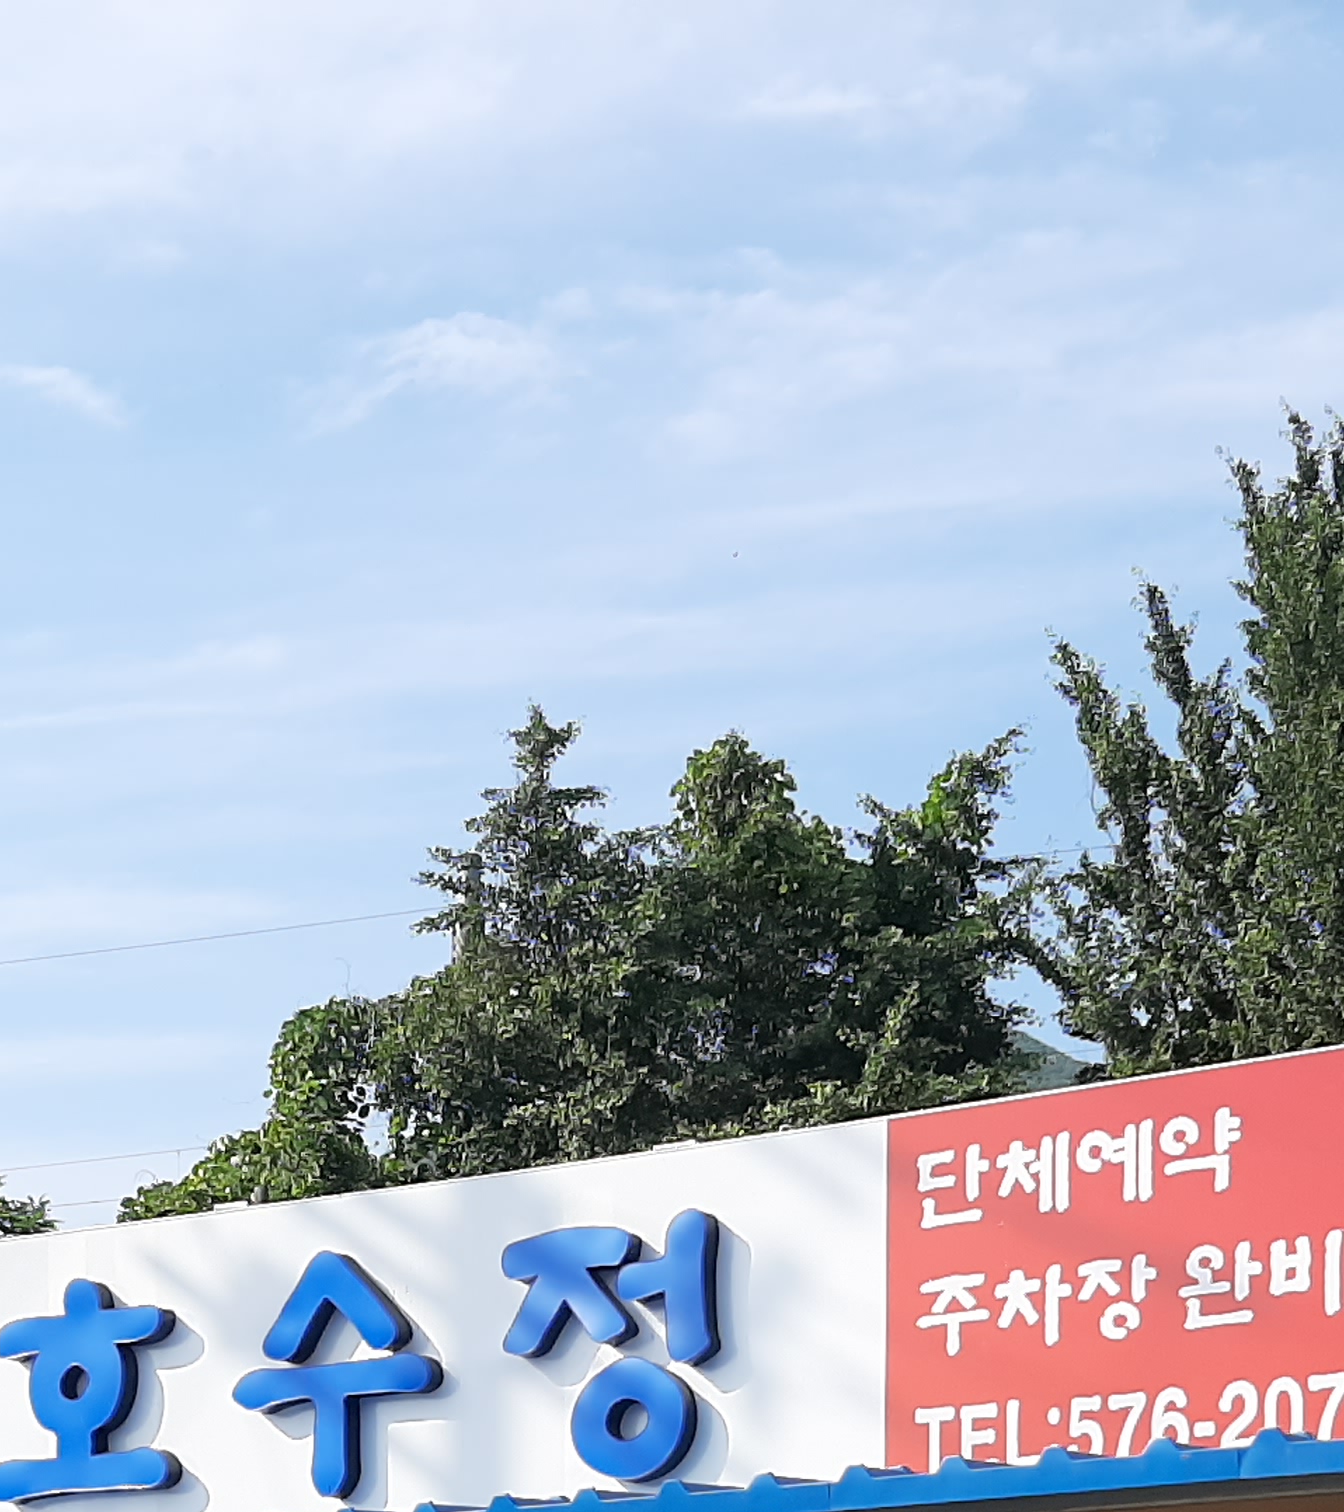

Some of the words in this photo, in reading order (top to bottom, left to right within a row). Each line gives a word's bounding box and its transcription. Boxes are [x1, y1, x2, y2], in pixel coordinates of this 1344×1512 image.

[916, 1106, 1243, 1229] 단체예약
[915, 1253, 1158, 1357] 주차장
[1178, 1228, 1344, 1331] 완비
